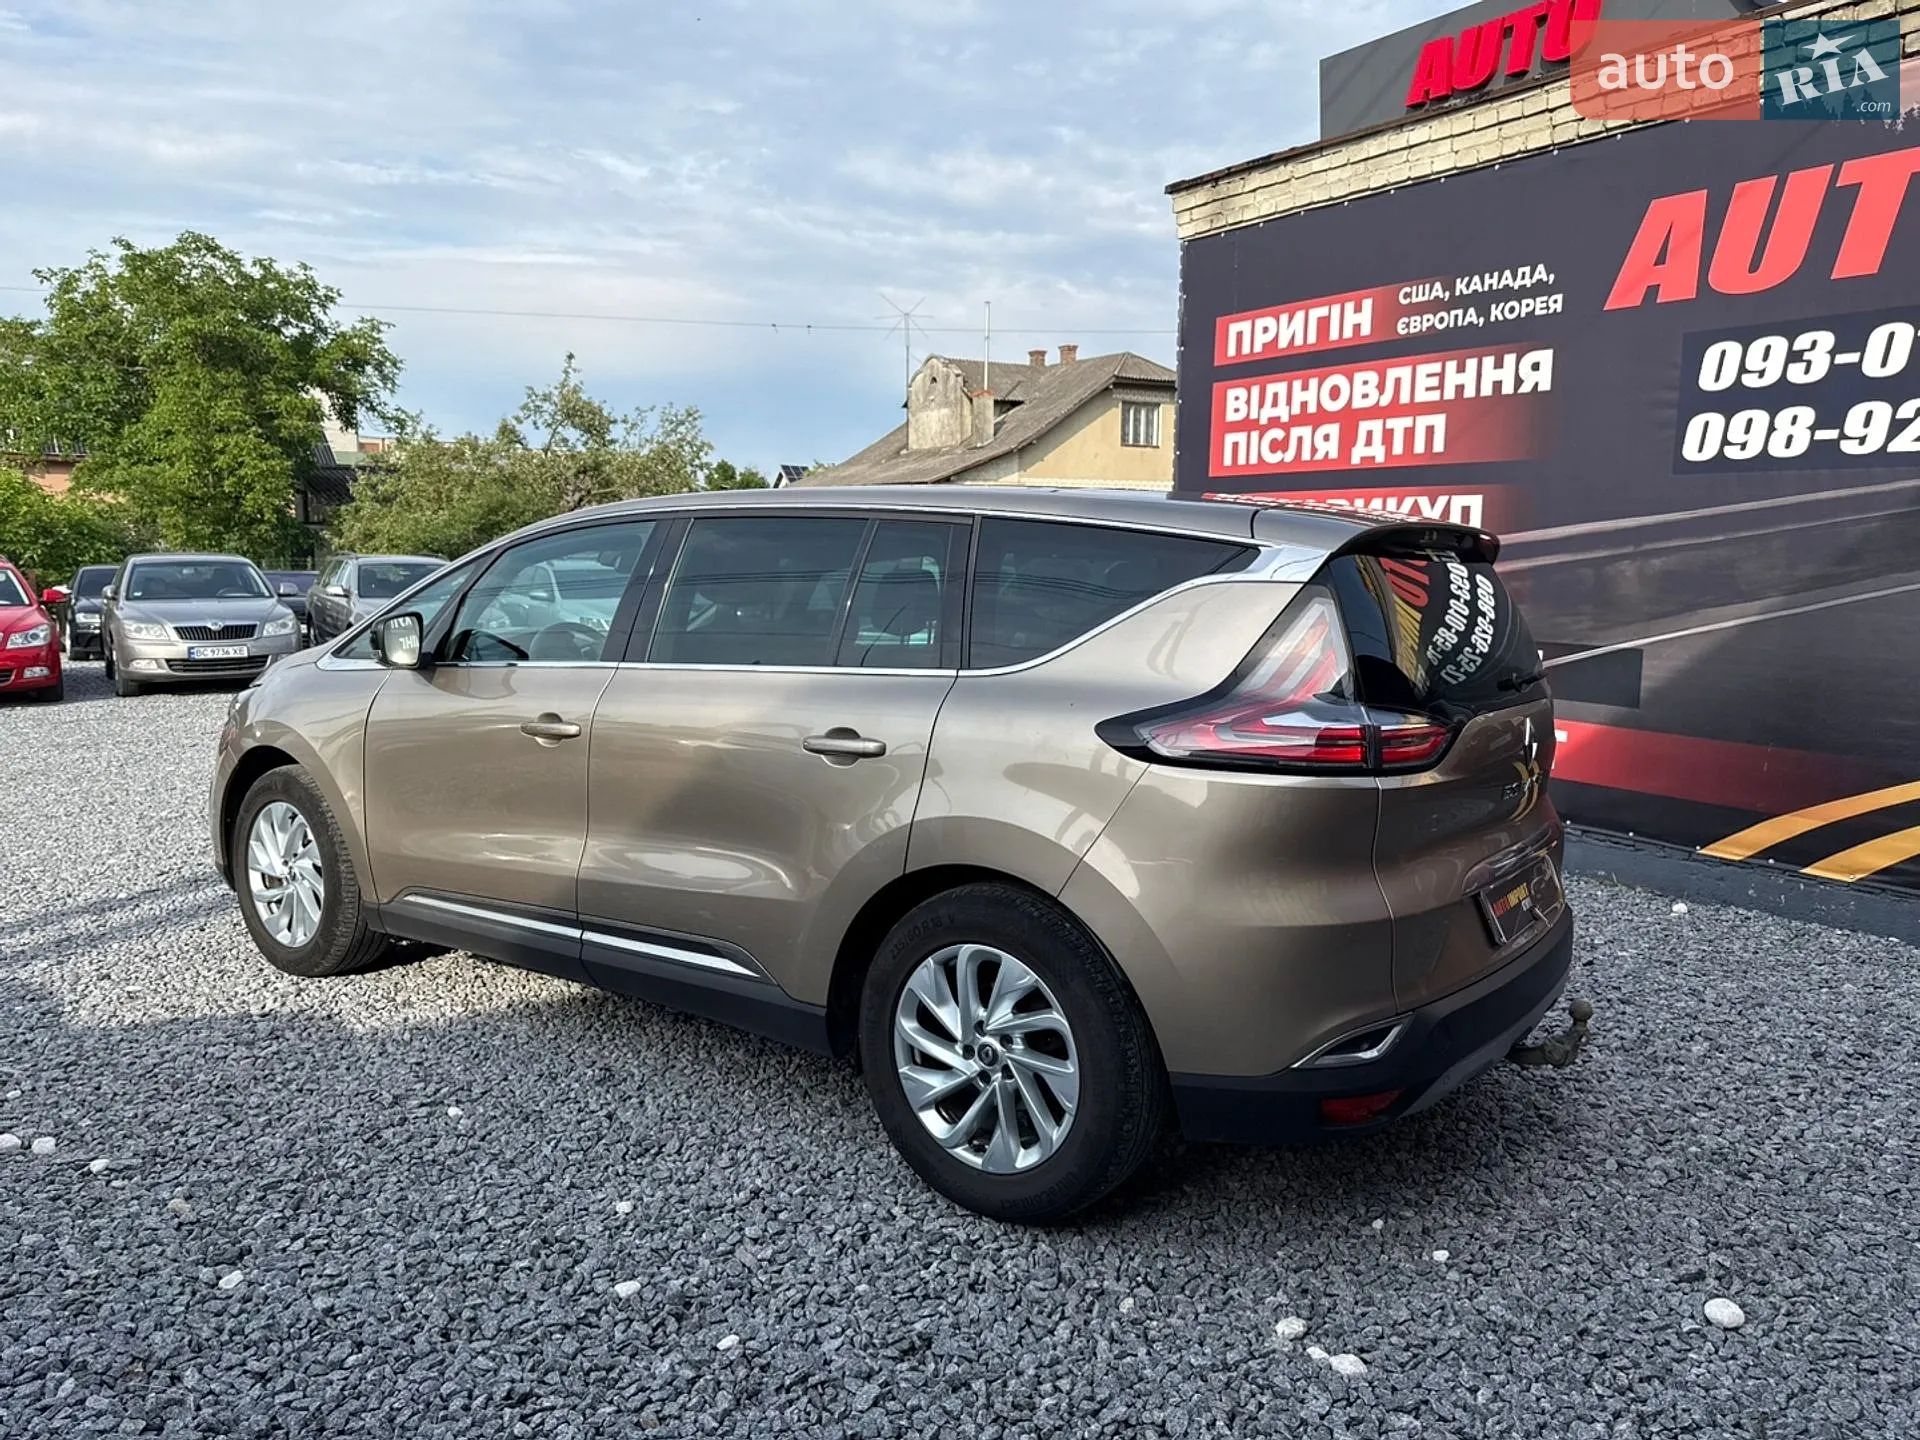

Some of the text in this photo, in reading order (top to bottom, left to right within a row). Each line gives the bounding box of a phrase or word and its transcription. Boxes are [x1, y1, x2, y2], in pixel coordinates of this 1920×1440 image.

[1398, 263, 1555, 305] США, КАНАДА,
[1227, 298, 1373, 358] ПРИГІН
[1397, 294, 1564, 335] ЄВРОПА, КОРЕЯ
[1698, 321, 1920, 392] 093-0
[1225, 349, 1554, 425] ВІДНОВЛЕННЯ
[1223, 413, 1447, 467] ПІСЛЯ ДТП
